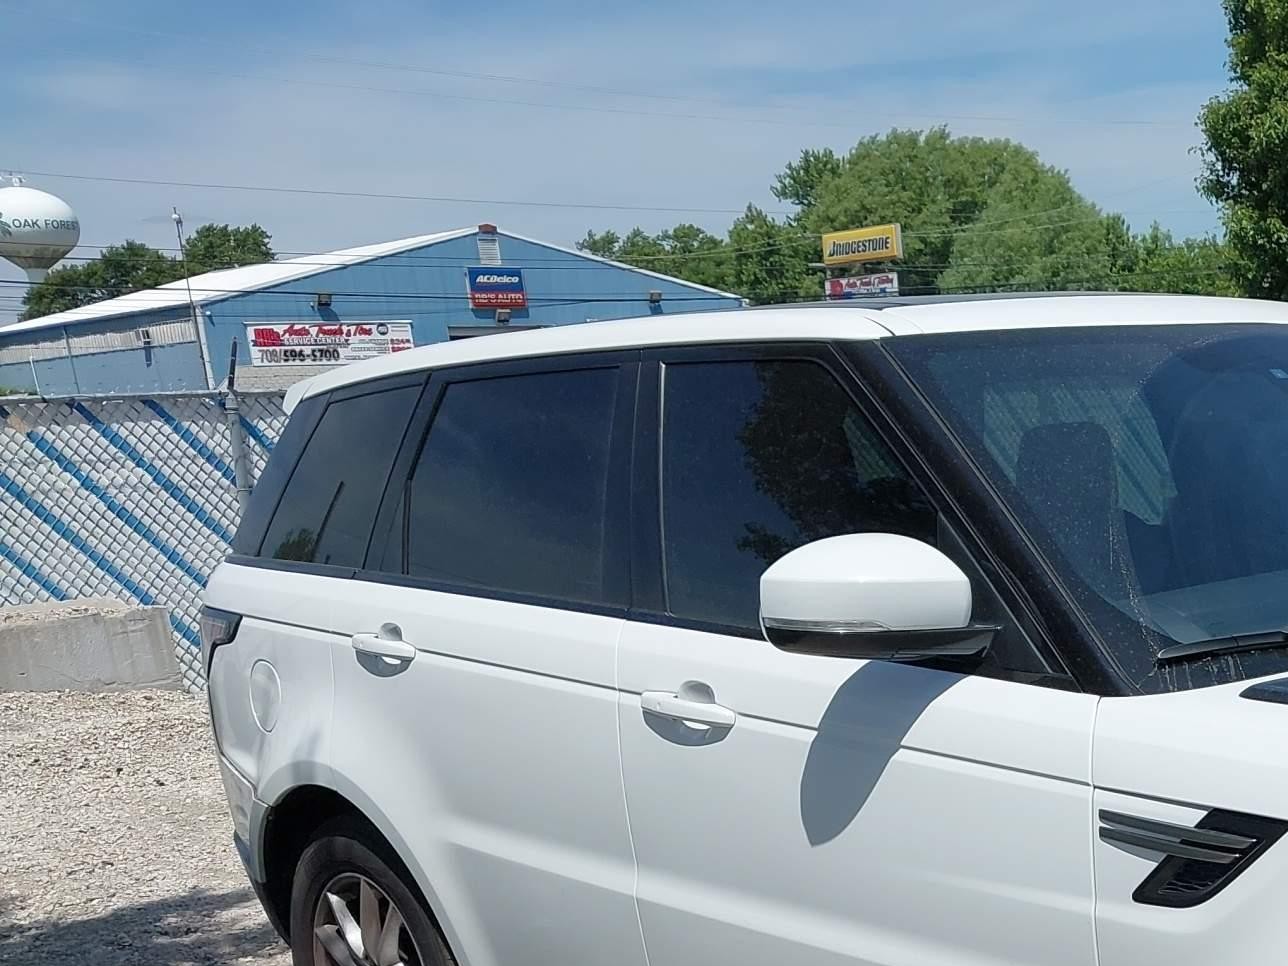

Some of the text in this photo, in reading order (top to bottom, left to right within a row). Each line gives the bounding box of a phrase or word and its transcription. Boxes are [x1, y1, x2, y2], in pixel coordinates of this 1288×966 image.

[12, 218, 79, 231] OAK FORES
[828, 236, 890, 257] BRIDGESTONE
[475, 274, 520, 283] ACDelco
[498, 293, 523, 303] AUTO
[284, 336, 346, 345] SERVICE CENTER
[257, 347, 340, 363] 708/596-5700
